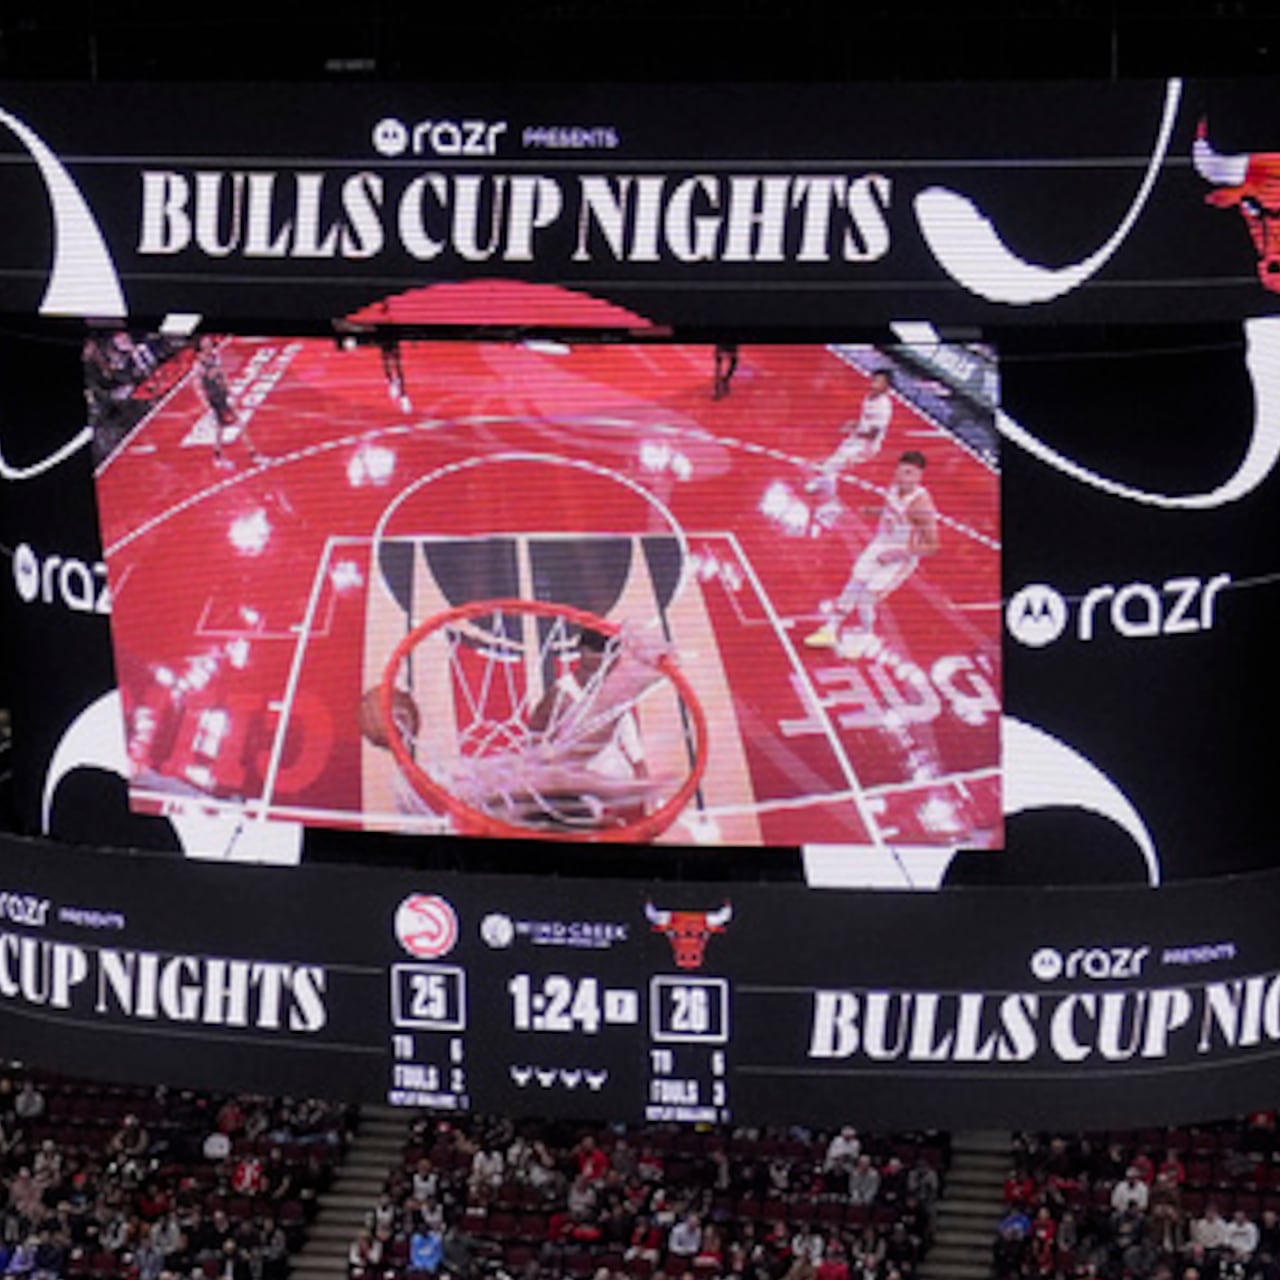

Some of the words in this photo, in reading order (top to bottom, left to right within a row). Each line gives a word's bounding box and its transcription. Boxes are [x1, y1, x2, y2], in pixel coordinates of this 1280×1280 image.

[413, 121, 507, 155] razr
[522, 127, 618, 148] PRESENTS
[137, 171, 384, 257] BULLS
[397, 172, 563, 261] CUP
[573, 173, 892, 262] NIGHTS
[42, 554, 112, 615] raz
[1079, 573, 1231, 640] razr
[95, 949, 327, 1032] NIGHTS
[1065, 946, 1150, 979] razr
[409, 974, 448, 1020] 25
[508, 974, 601, 1033] 1:24
[809, 989, 1040, 1062] BULLS
[1050, 989, 1193, 1062] CUP
